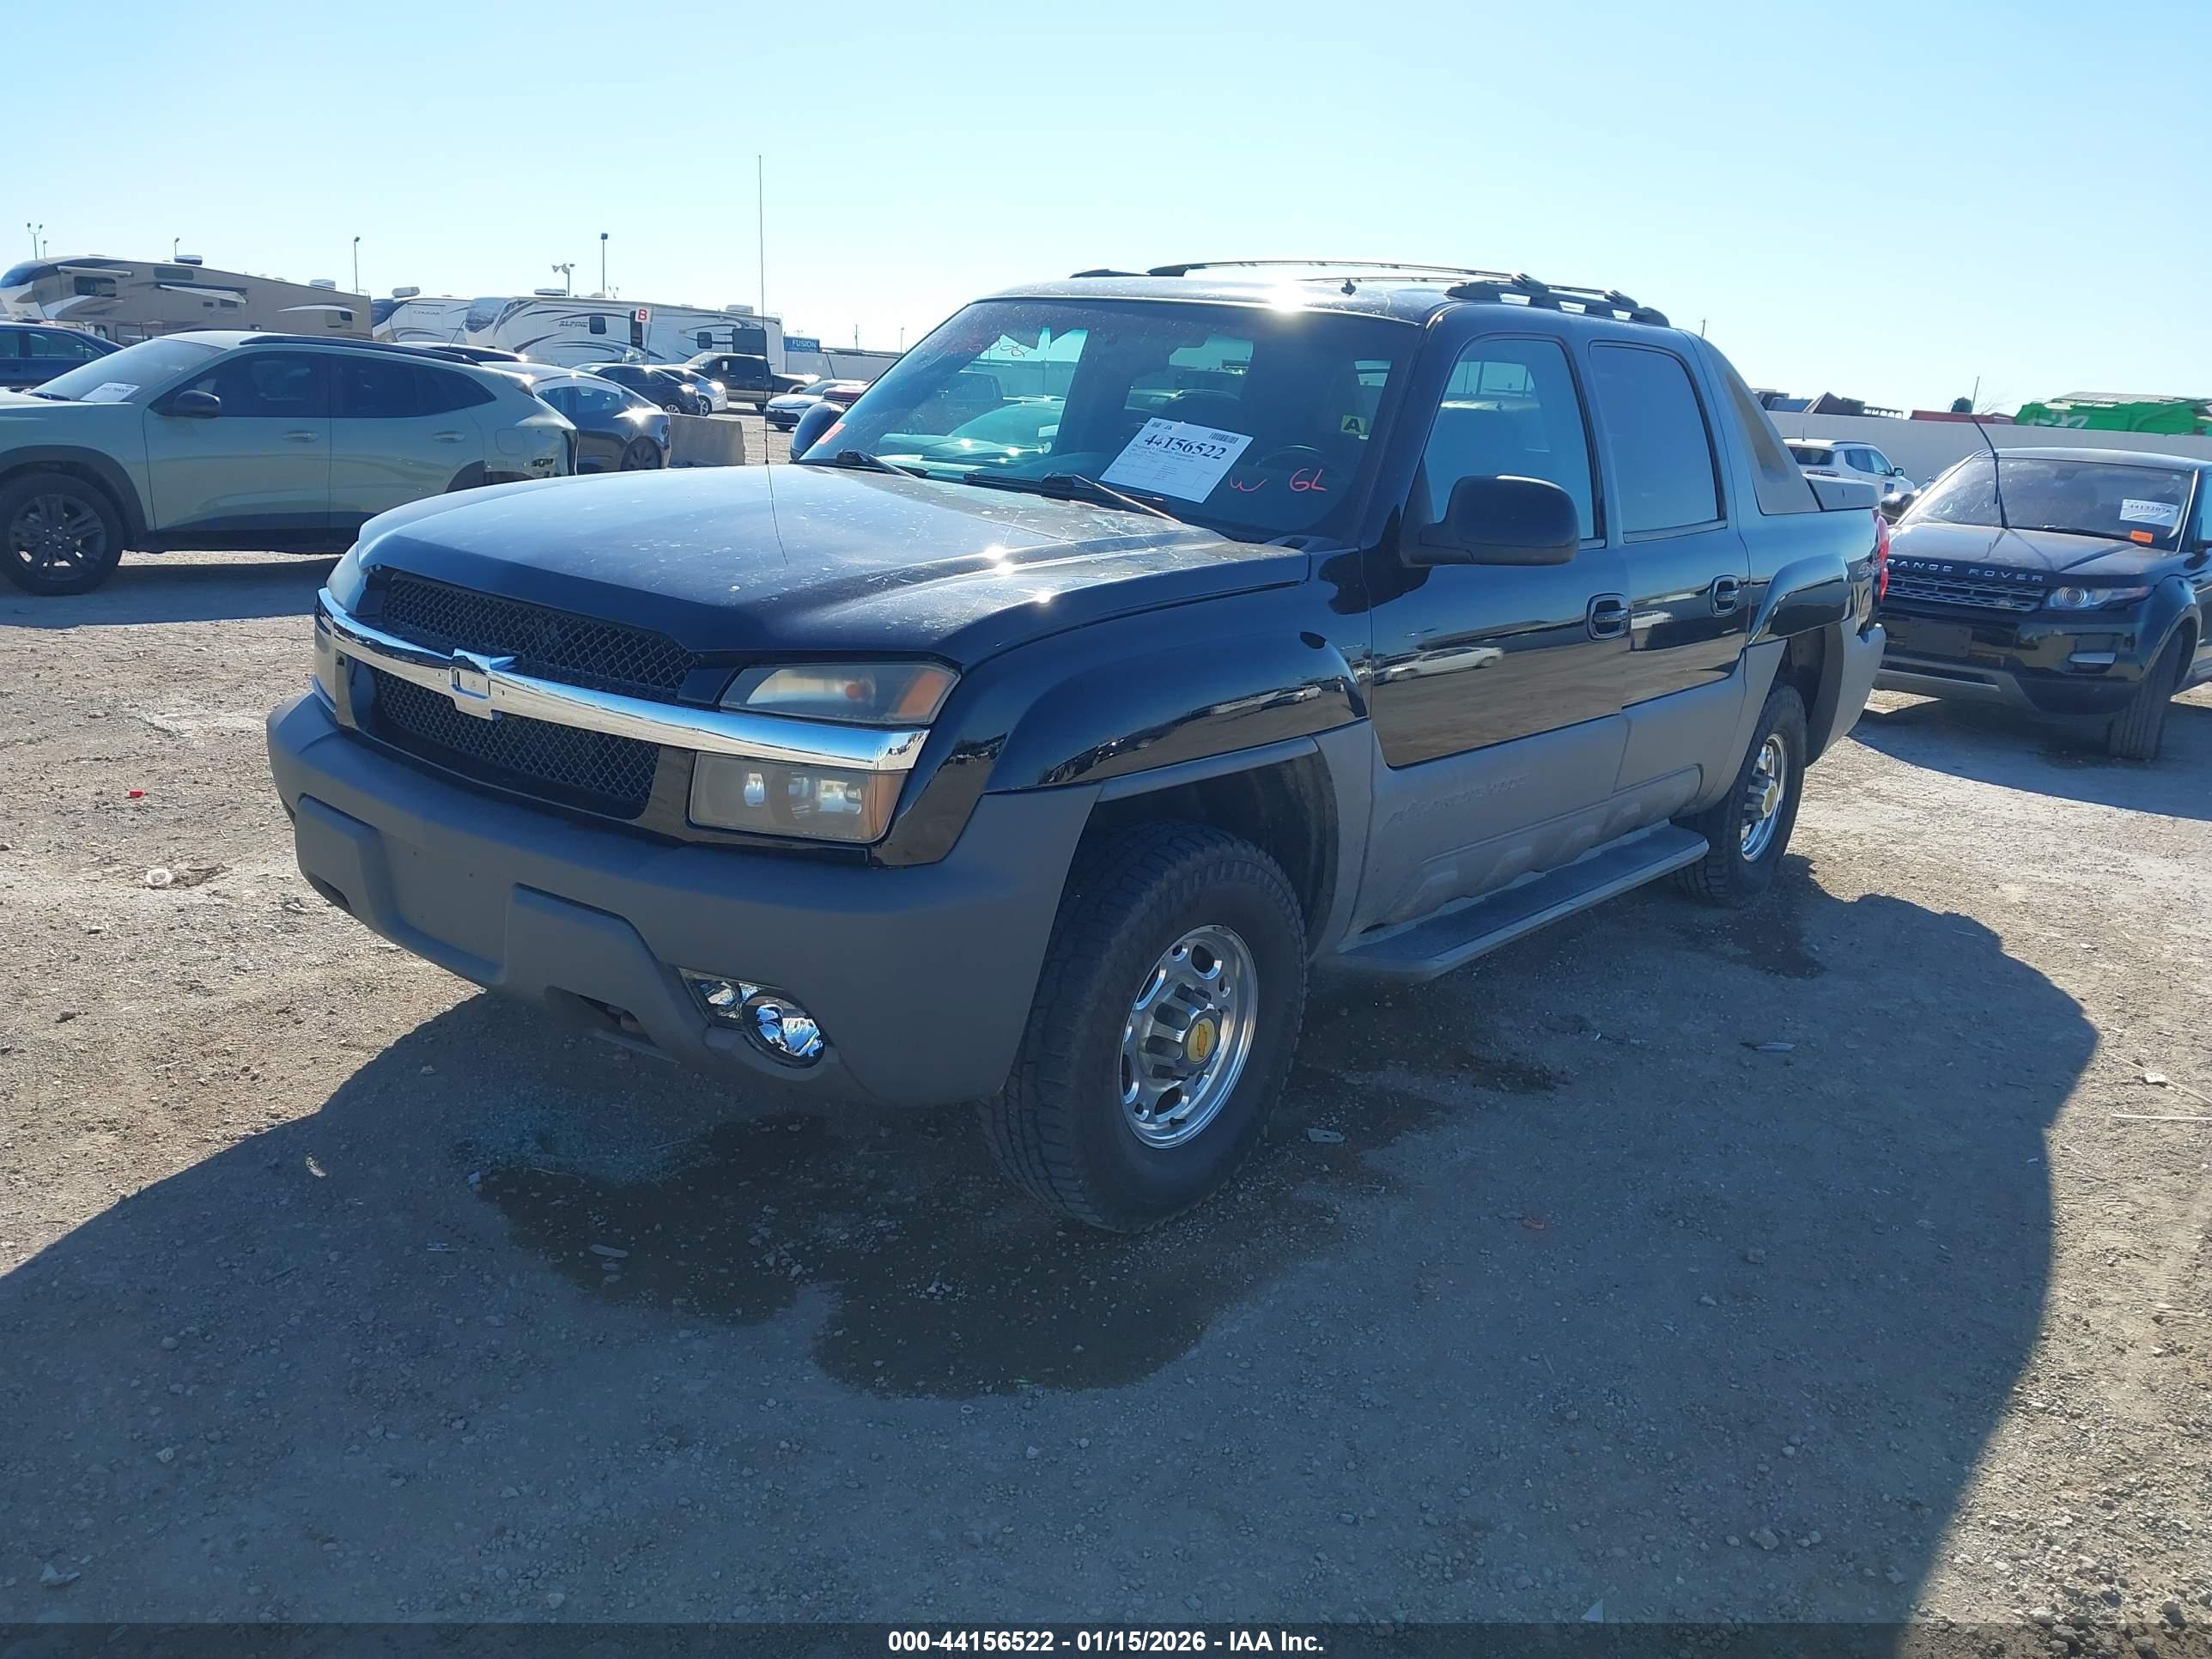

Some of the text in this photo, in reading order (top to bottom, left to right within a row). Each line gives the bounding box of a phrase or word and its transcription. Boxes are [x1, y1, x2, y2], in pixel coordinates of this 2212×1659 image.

[638, 309, 647, 320] B
[792, 338, 817, 349] FUSION
[1343, 417, 1361, 433] A
[1145, 434, 1227, 460] 44156522
[1968, 568, 2044, 583] ROVER
